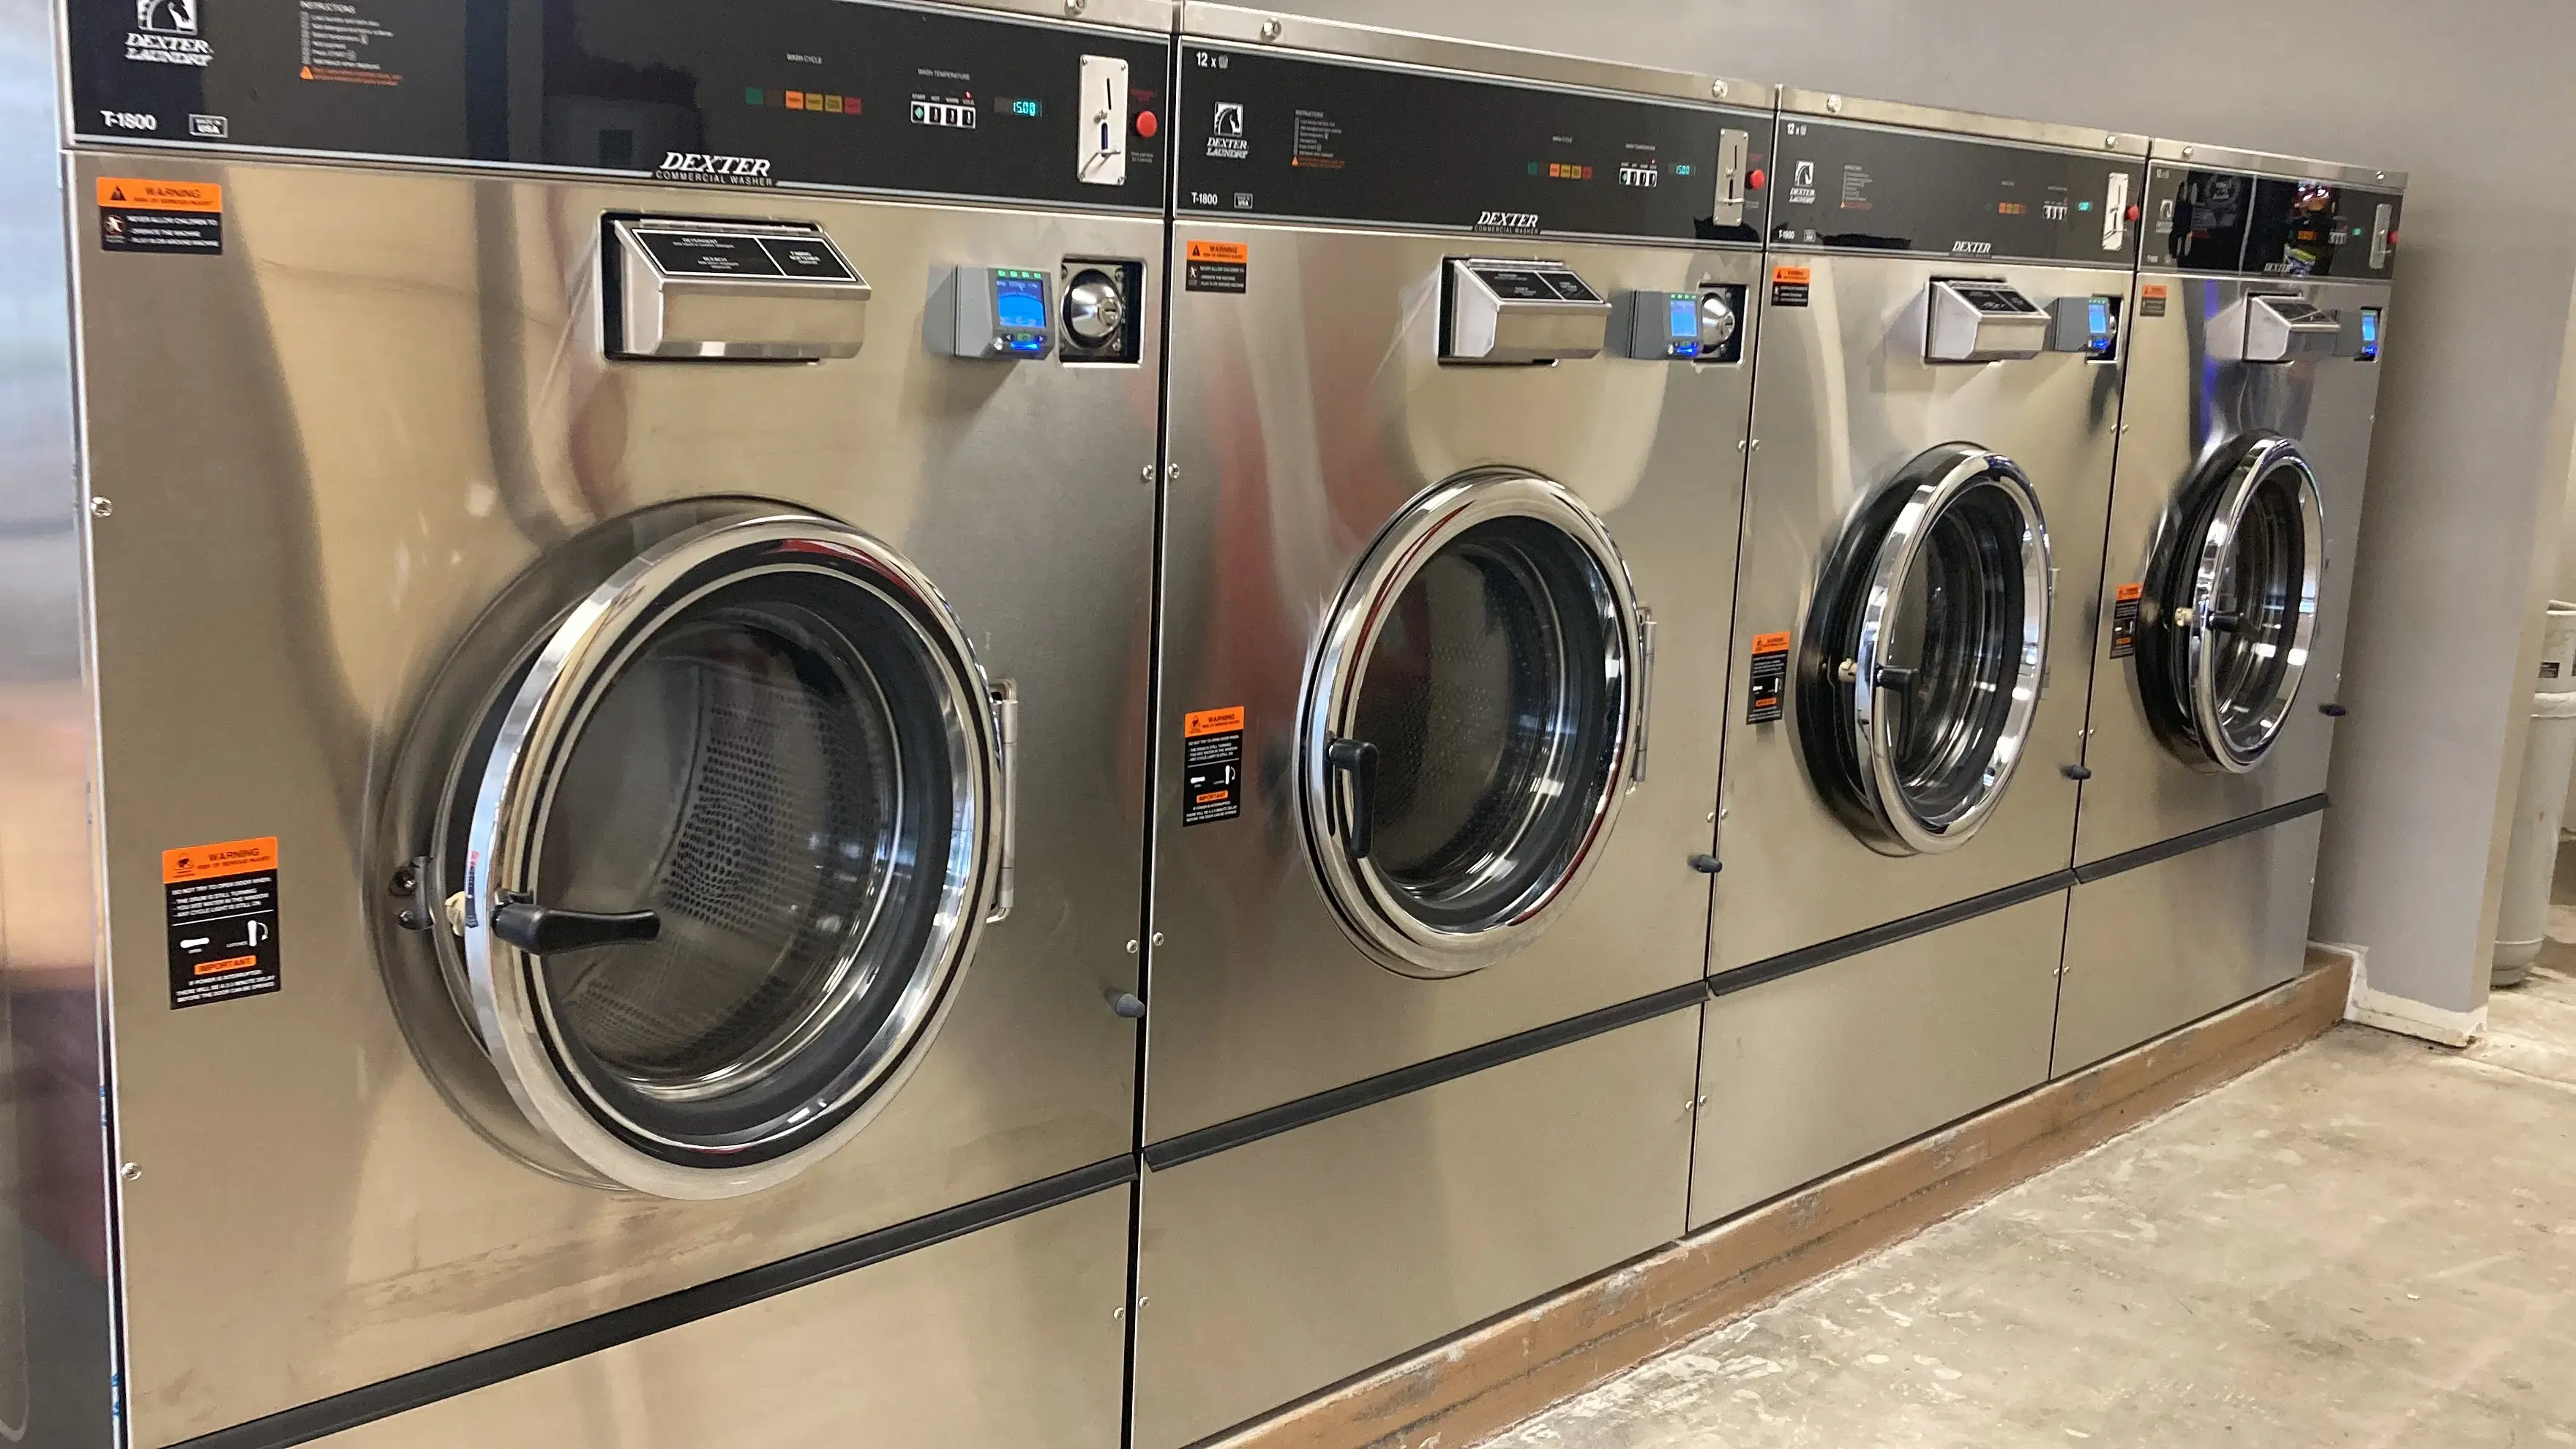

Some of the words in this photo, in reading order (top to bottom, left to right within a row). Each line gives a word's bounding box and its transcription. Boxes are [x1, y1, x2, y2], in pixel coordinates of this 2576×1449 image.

[124, 32, 213, 53] DEXTER
[1196, 51, 1208, 67] 12
[100, 110, 157, 131] T-1800
[1207, 137, 1248, 149] DEXTER
[1206, 147, 1249, 159] LAUNDRY
[659, 151, 771, 177] DEXTER
[655, 170, 725, 183] COMMERCIAL
[730, 175, 772, 187] WASHER
[1191, 192, 1218, 205] T-1800
[1477, 211, 1538, 228] DEXTER
[1952, 241, 1991, 253] DEXTER
[209, 847, 260, 862] WARNING
